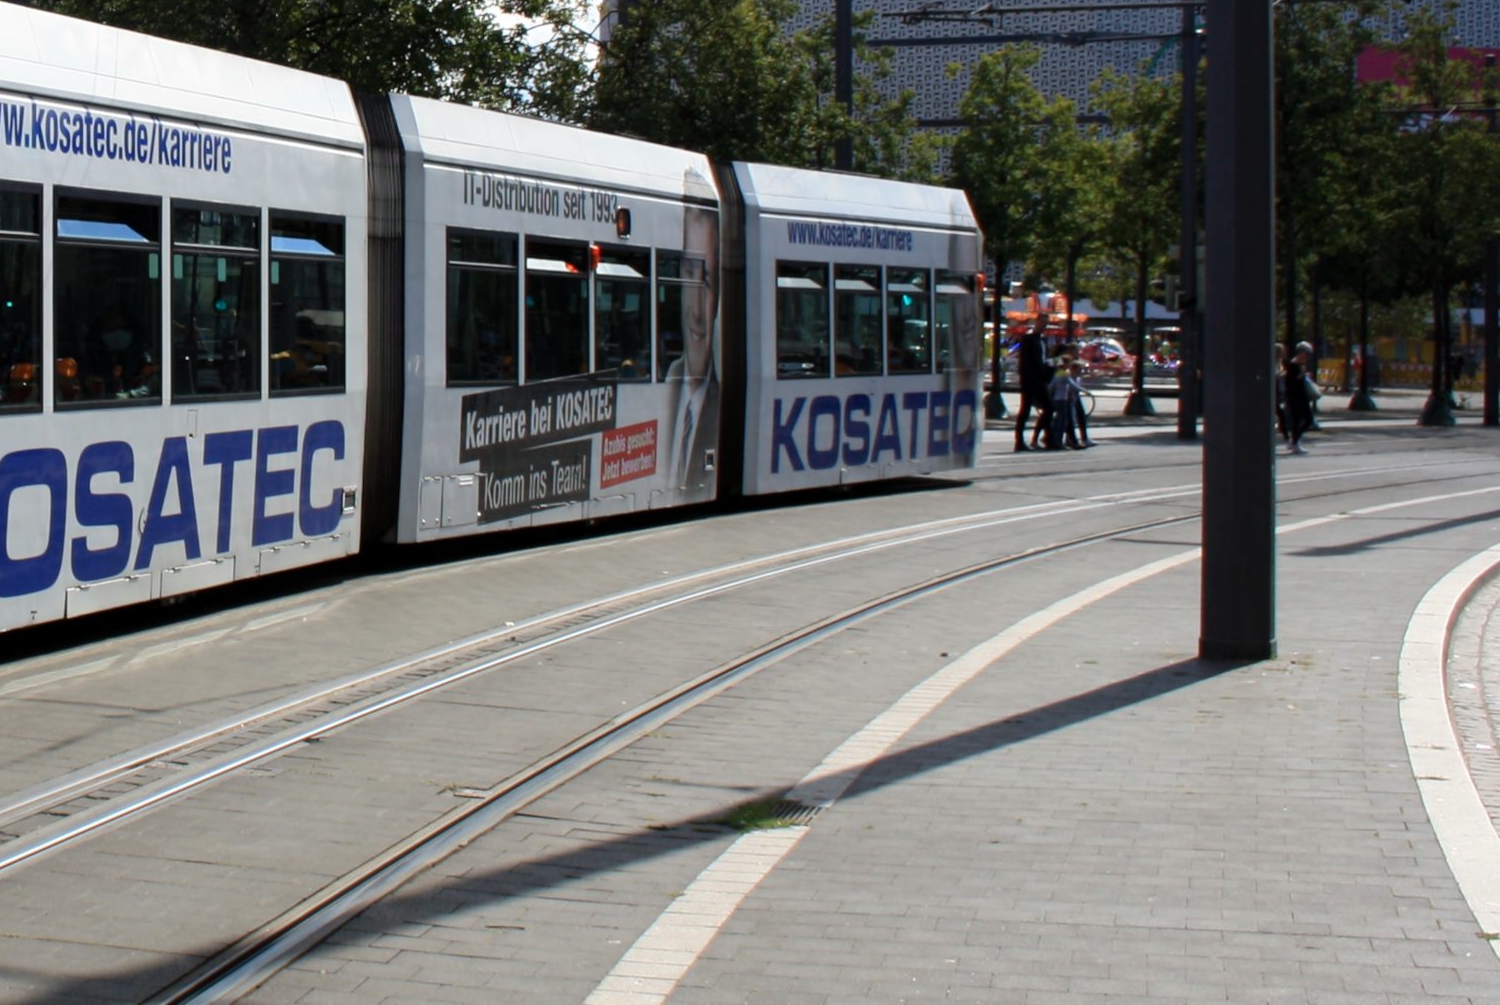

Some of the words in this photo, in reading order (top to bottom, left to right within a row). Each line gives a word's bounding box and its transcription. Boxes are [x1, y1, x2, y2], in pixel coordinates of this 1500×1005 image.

[463, 172, 559, 217] IT-Distribution
[563, 189, 586, 221] seit
[589, 194, 618, 224] 1993
[466, 405, 526, 449] Karriere
[530, 399, 552, 436] bei
[556, 386, 613, 430] KOSATEC
[770, 389, 976, 474] KOSATEC
[484, 472, 525, 511] Komm
[529, 464, 547, 501] ins
[551, 454, 586, 494] Team!
